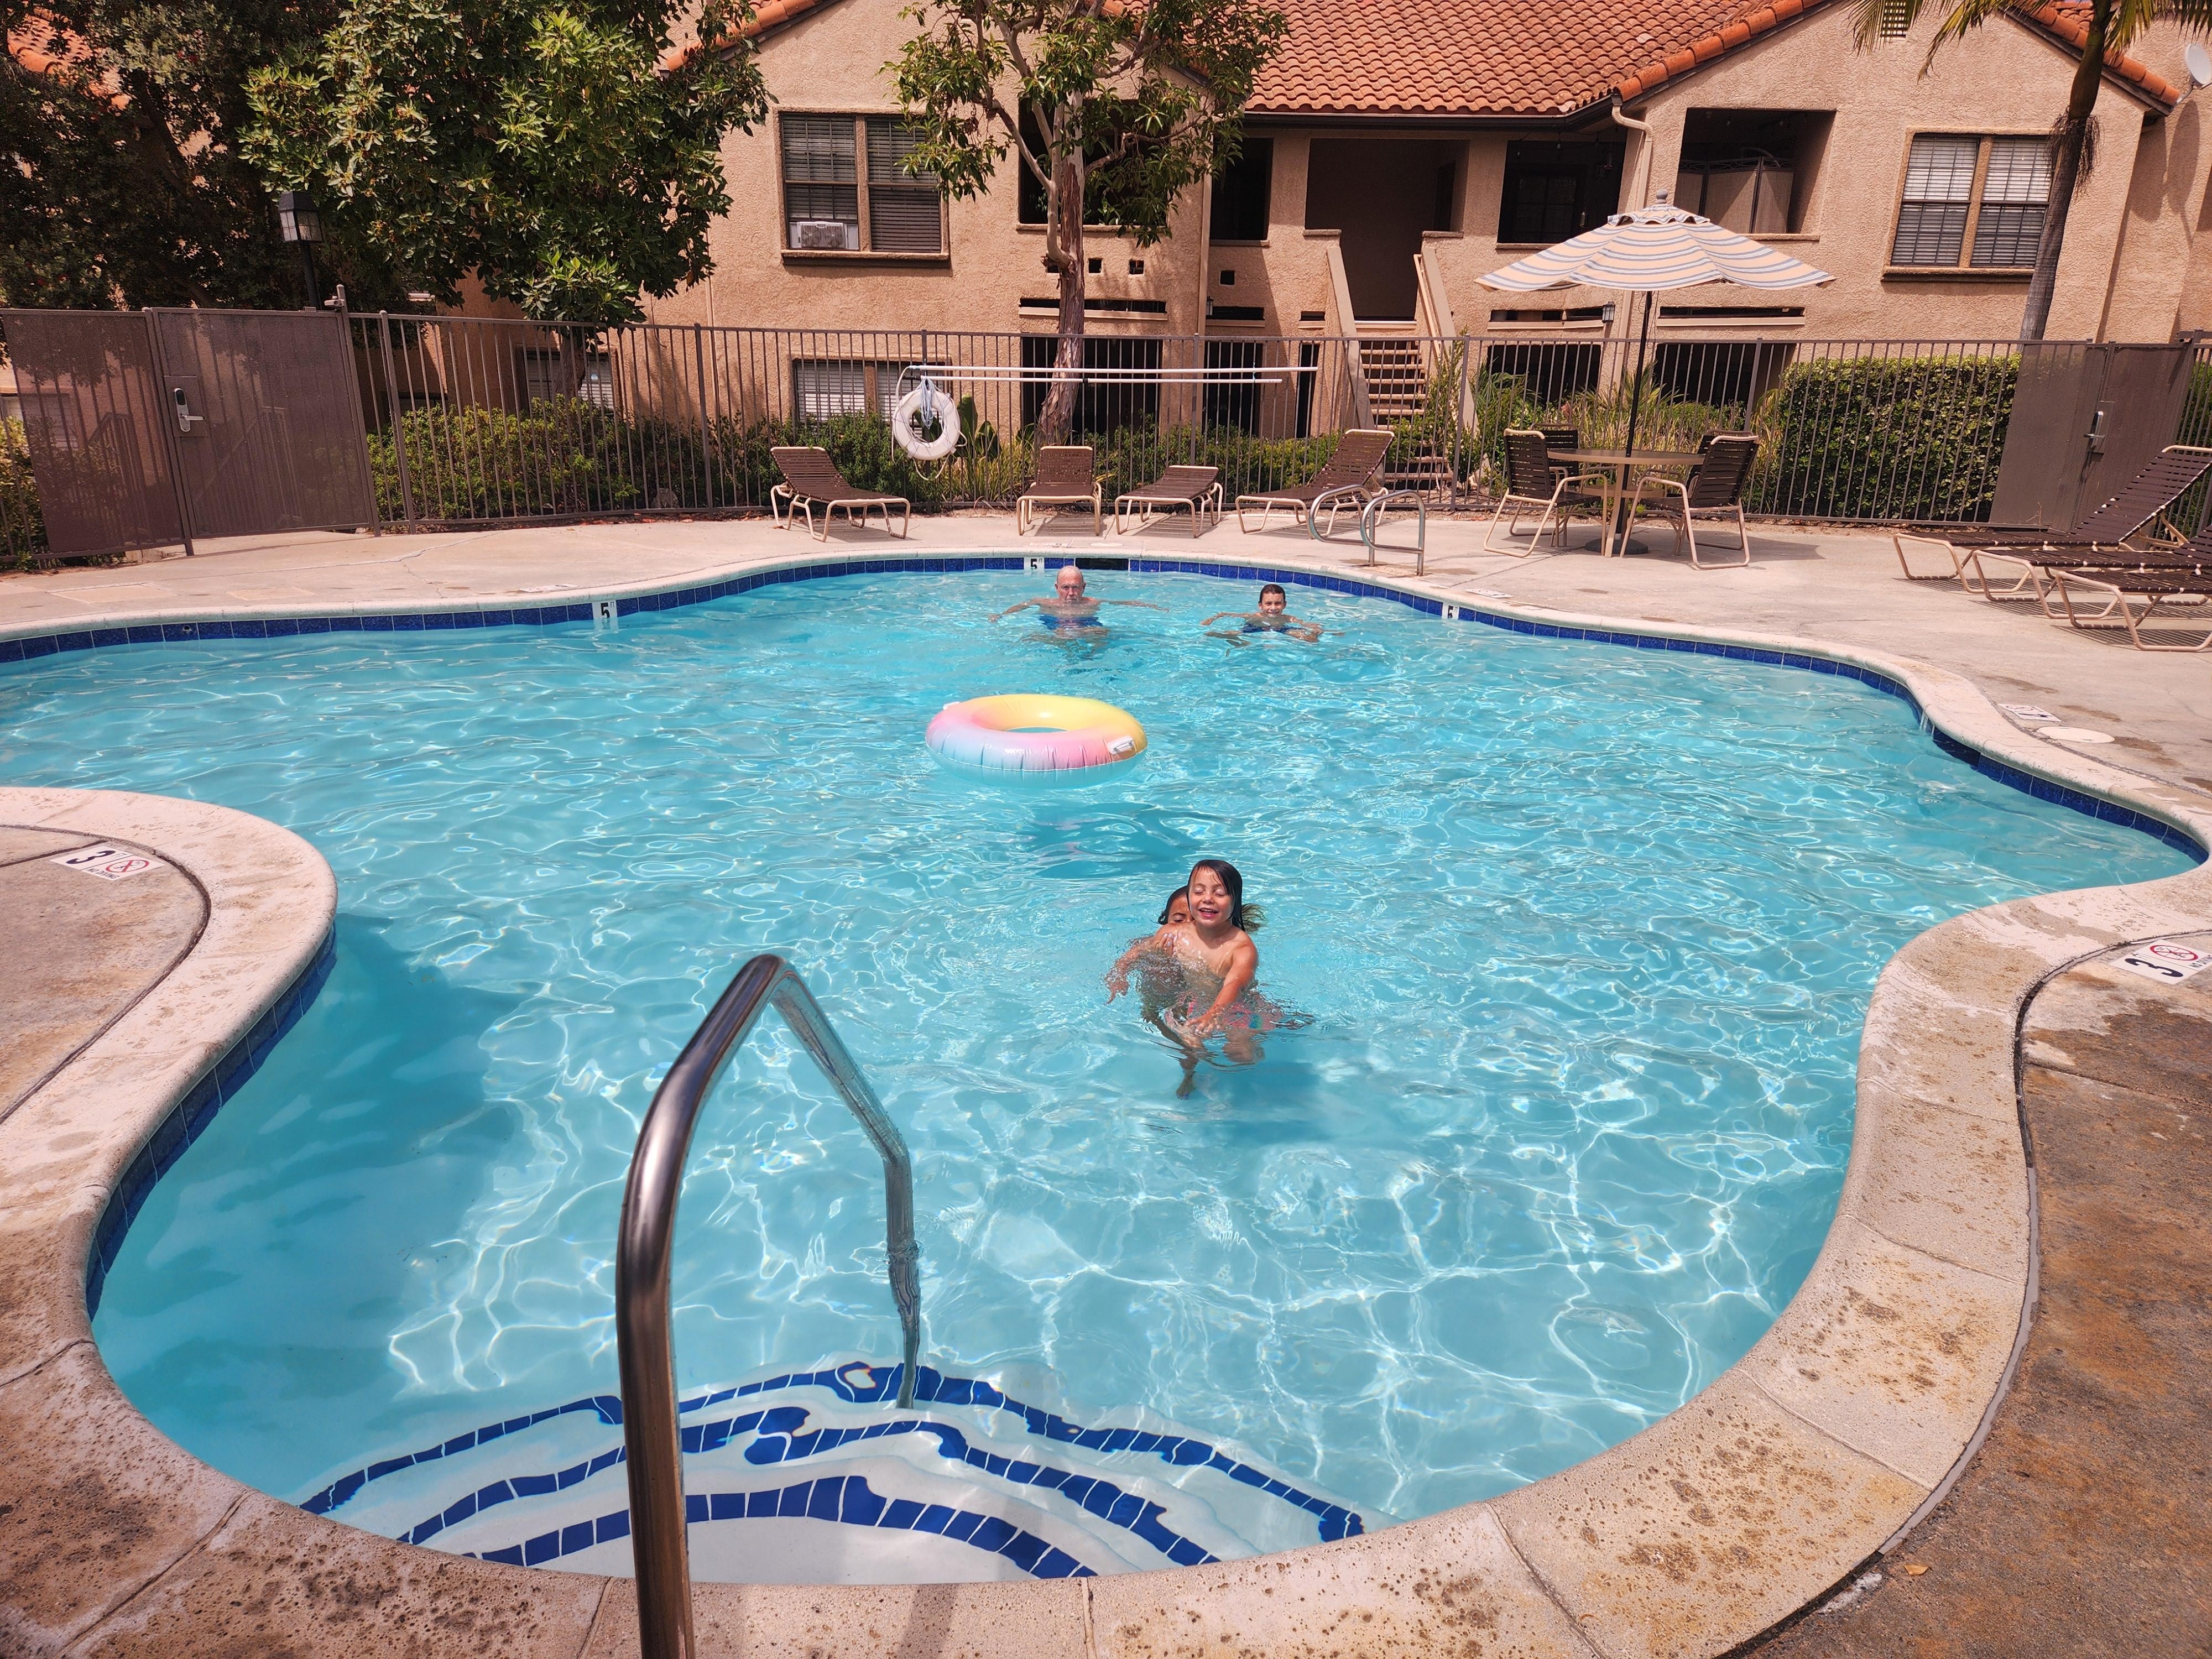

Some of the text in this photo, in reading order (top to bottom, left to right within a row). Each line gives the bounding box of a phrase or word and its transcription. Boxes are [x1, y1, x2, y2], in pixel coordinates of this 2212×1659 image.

[1030, 559, 1037, 570] 5
[601, 602, 611, 619] 5
[1447, 605, 1454, 619] 5
[66, 850, 116, 864] 3
[2124, 958, 2184, 977] 3
